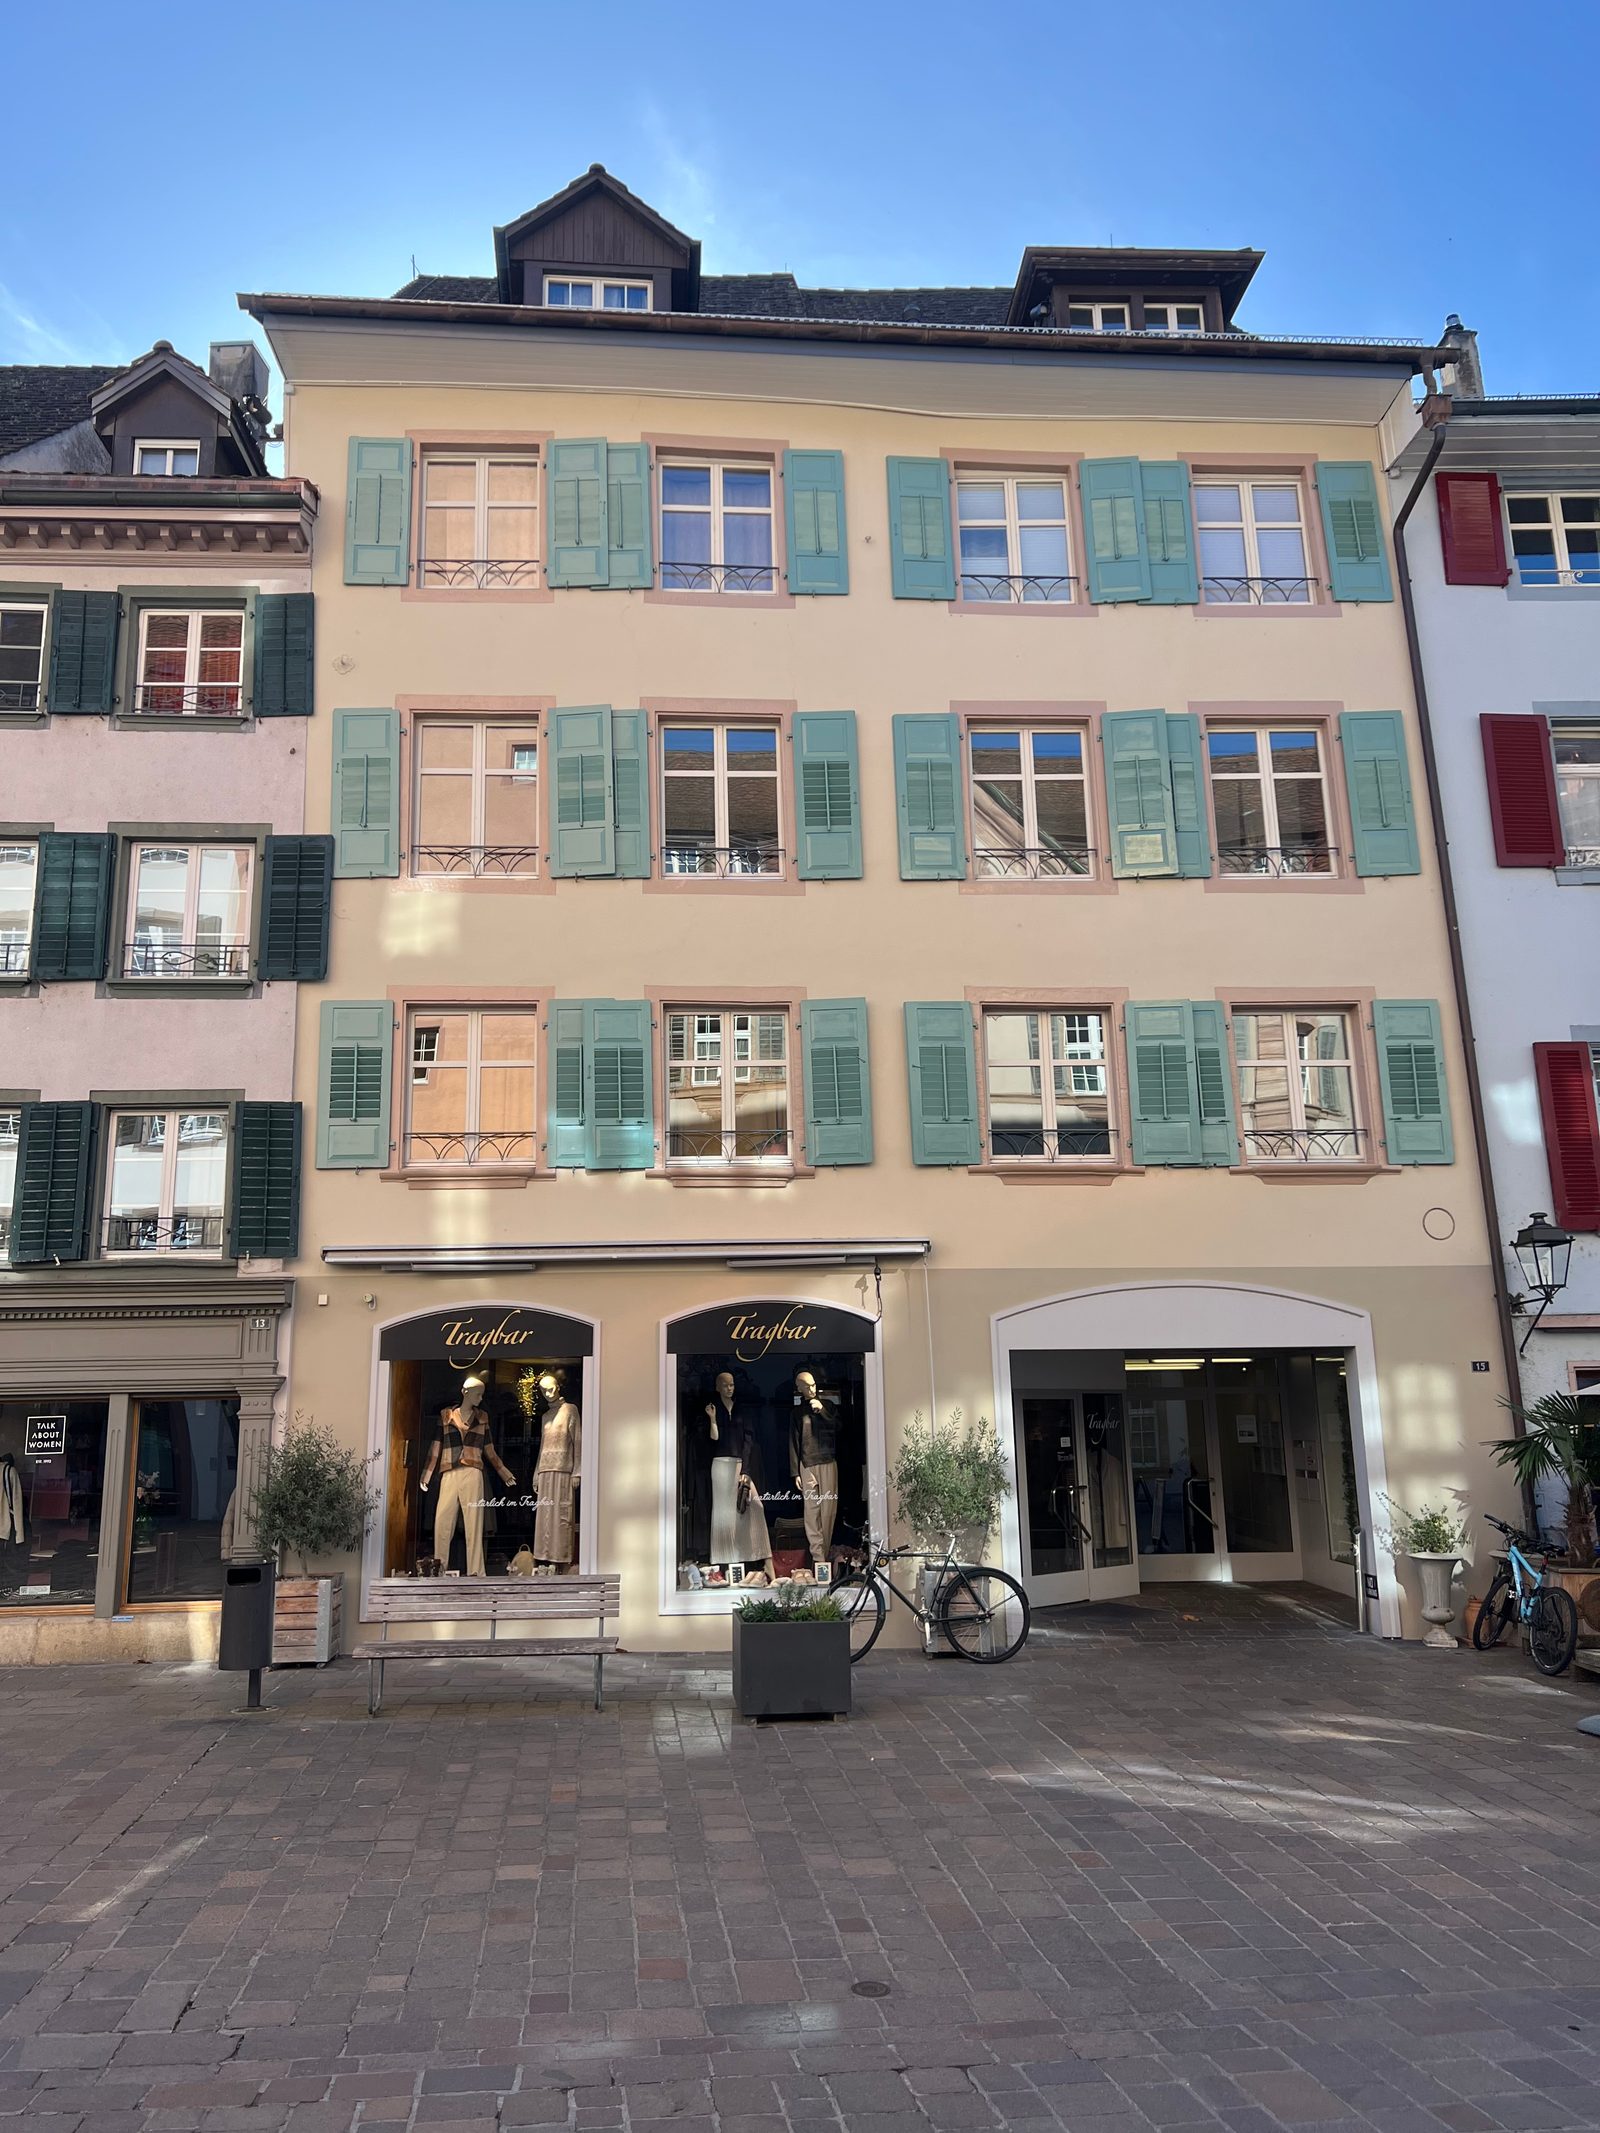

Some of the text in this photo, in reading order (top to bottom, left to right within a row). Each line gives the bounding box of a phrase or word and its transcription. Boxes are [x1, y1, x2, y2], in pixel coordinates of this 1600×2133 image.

[255, 1319, 266, 1328] 13
[726, 1304, 817, 1362] Tragbar
[441, 1309, 534, 1370] Tragbar
[1476, 1362, 1486, 1371] 15
[36, 1422, 56, 1430] TALK
[1086, 1407, 1120, 1445] Tragbar
[31, 1431, 60, 1439] ABOUT
[28, 1440, 62, 1449] WOMEN
[506, 1499, 517, 1507] im
[519, 1495, 555, 1511] Tragbar
[791, 1493, 802, 1501] im
[803, 1489, 838, 1505] Tragbar
